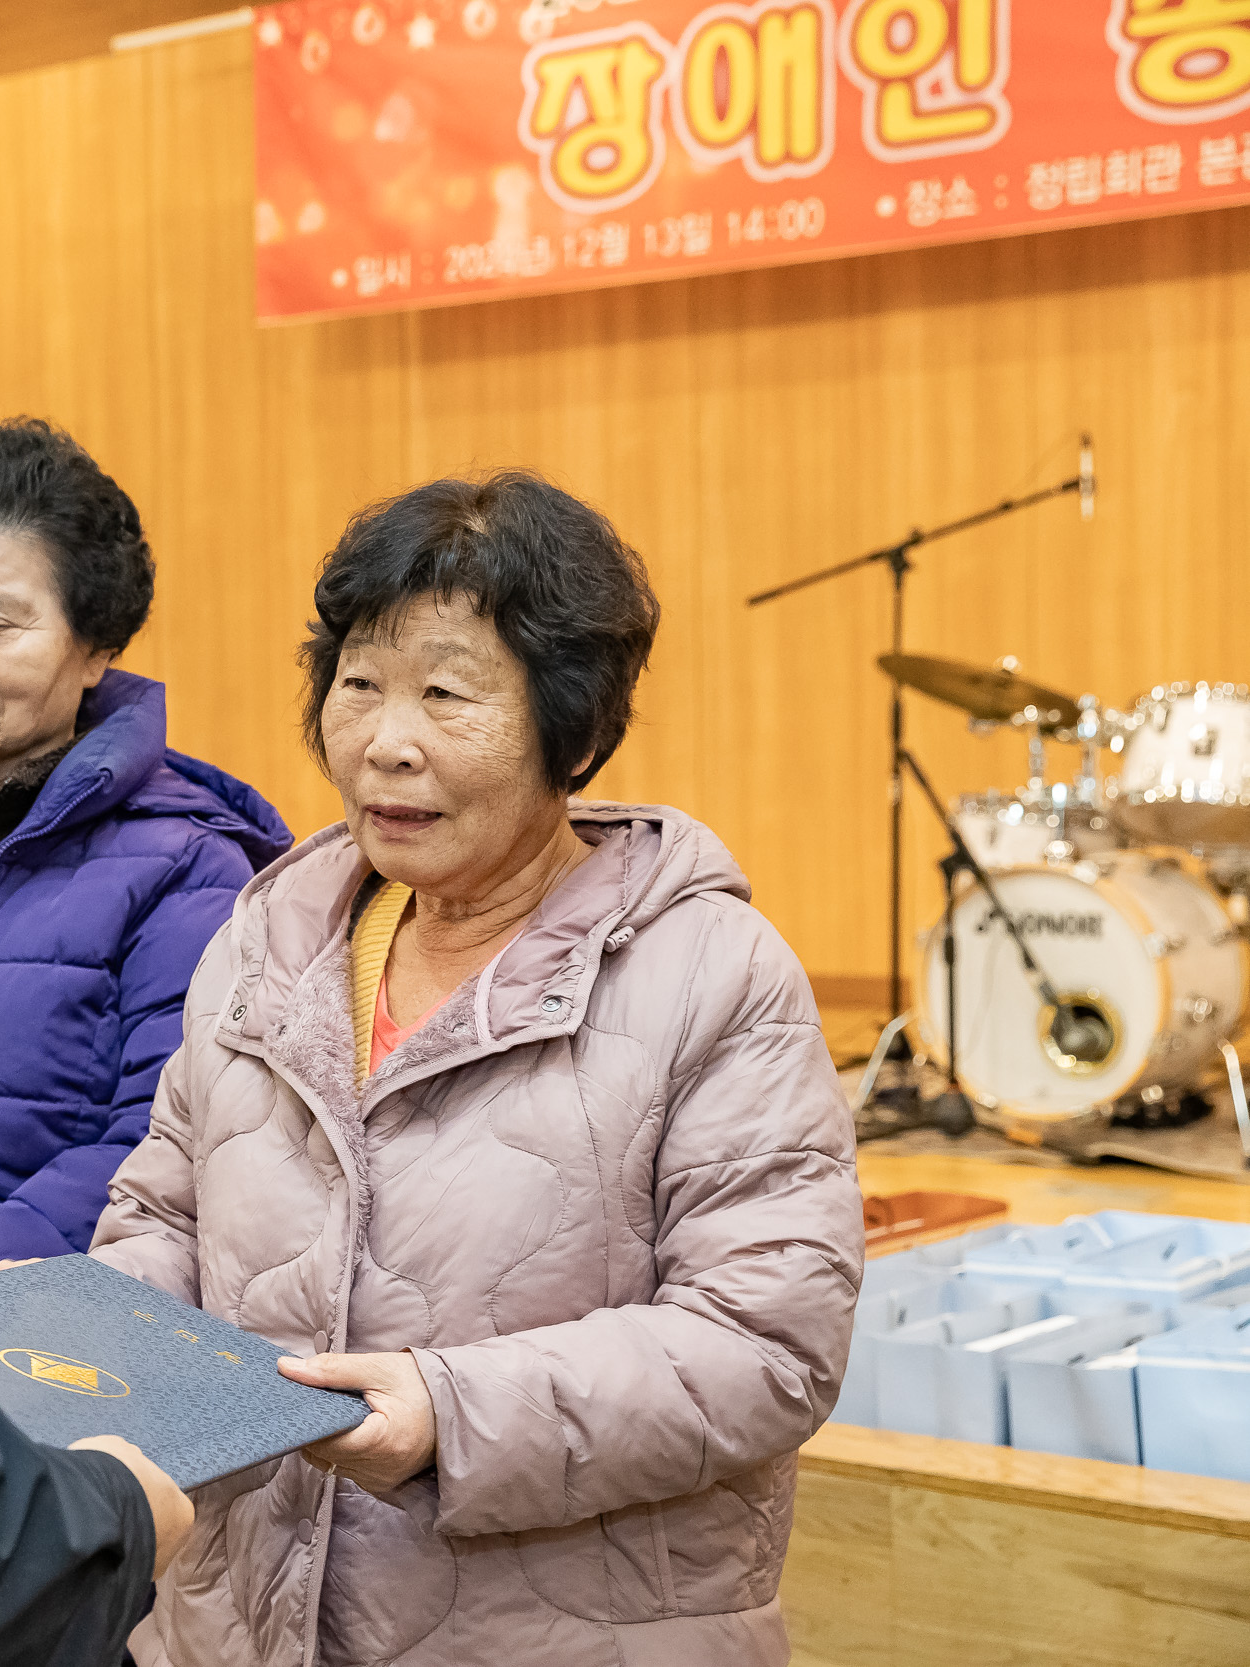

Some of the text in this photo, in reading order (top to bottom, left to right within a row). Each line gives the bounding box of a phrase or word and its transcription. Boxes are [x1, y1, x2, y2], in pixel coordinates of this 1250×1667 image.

[519, 0, 1011, 212] 장애인
[354, 255, 411, 297] 일시
[563, 219, 631, 268] 12월
[644, 208, 713, 258] 13일
[727, 196, 826, 246] 14:00
[906, 175, 978, 228] 장소
[1199, 132, 1250, 186] 본
